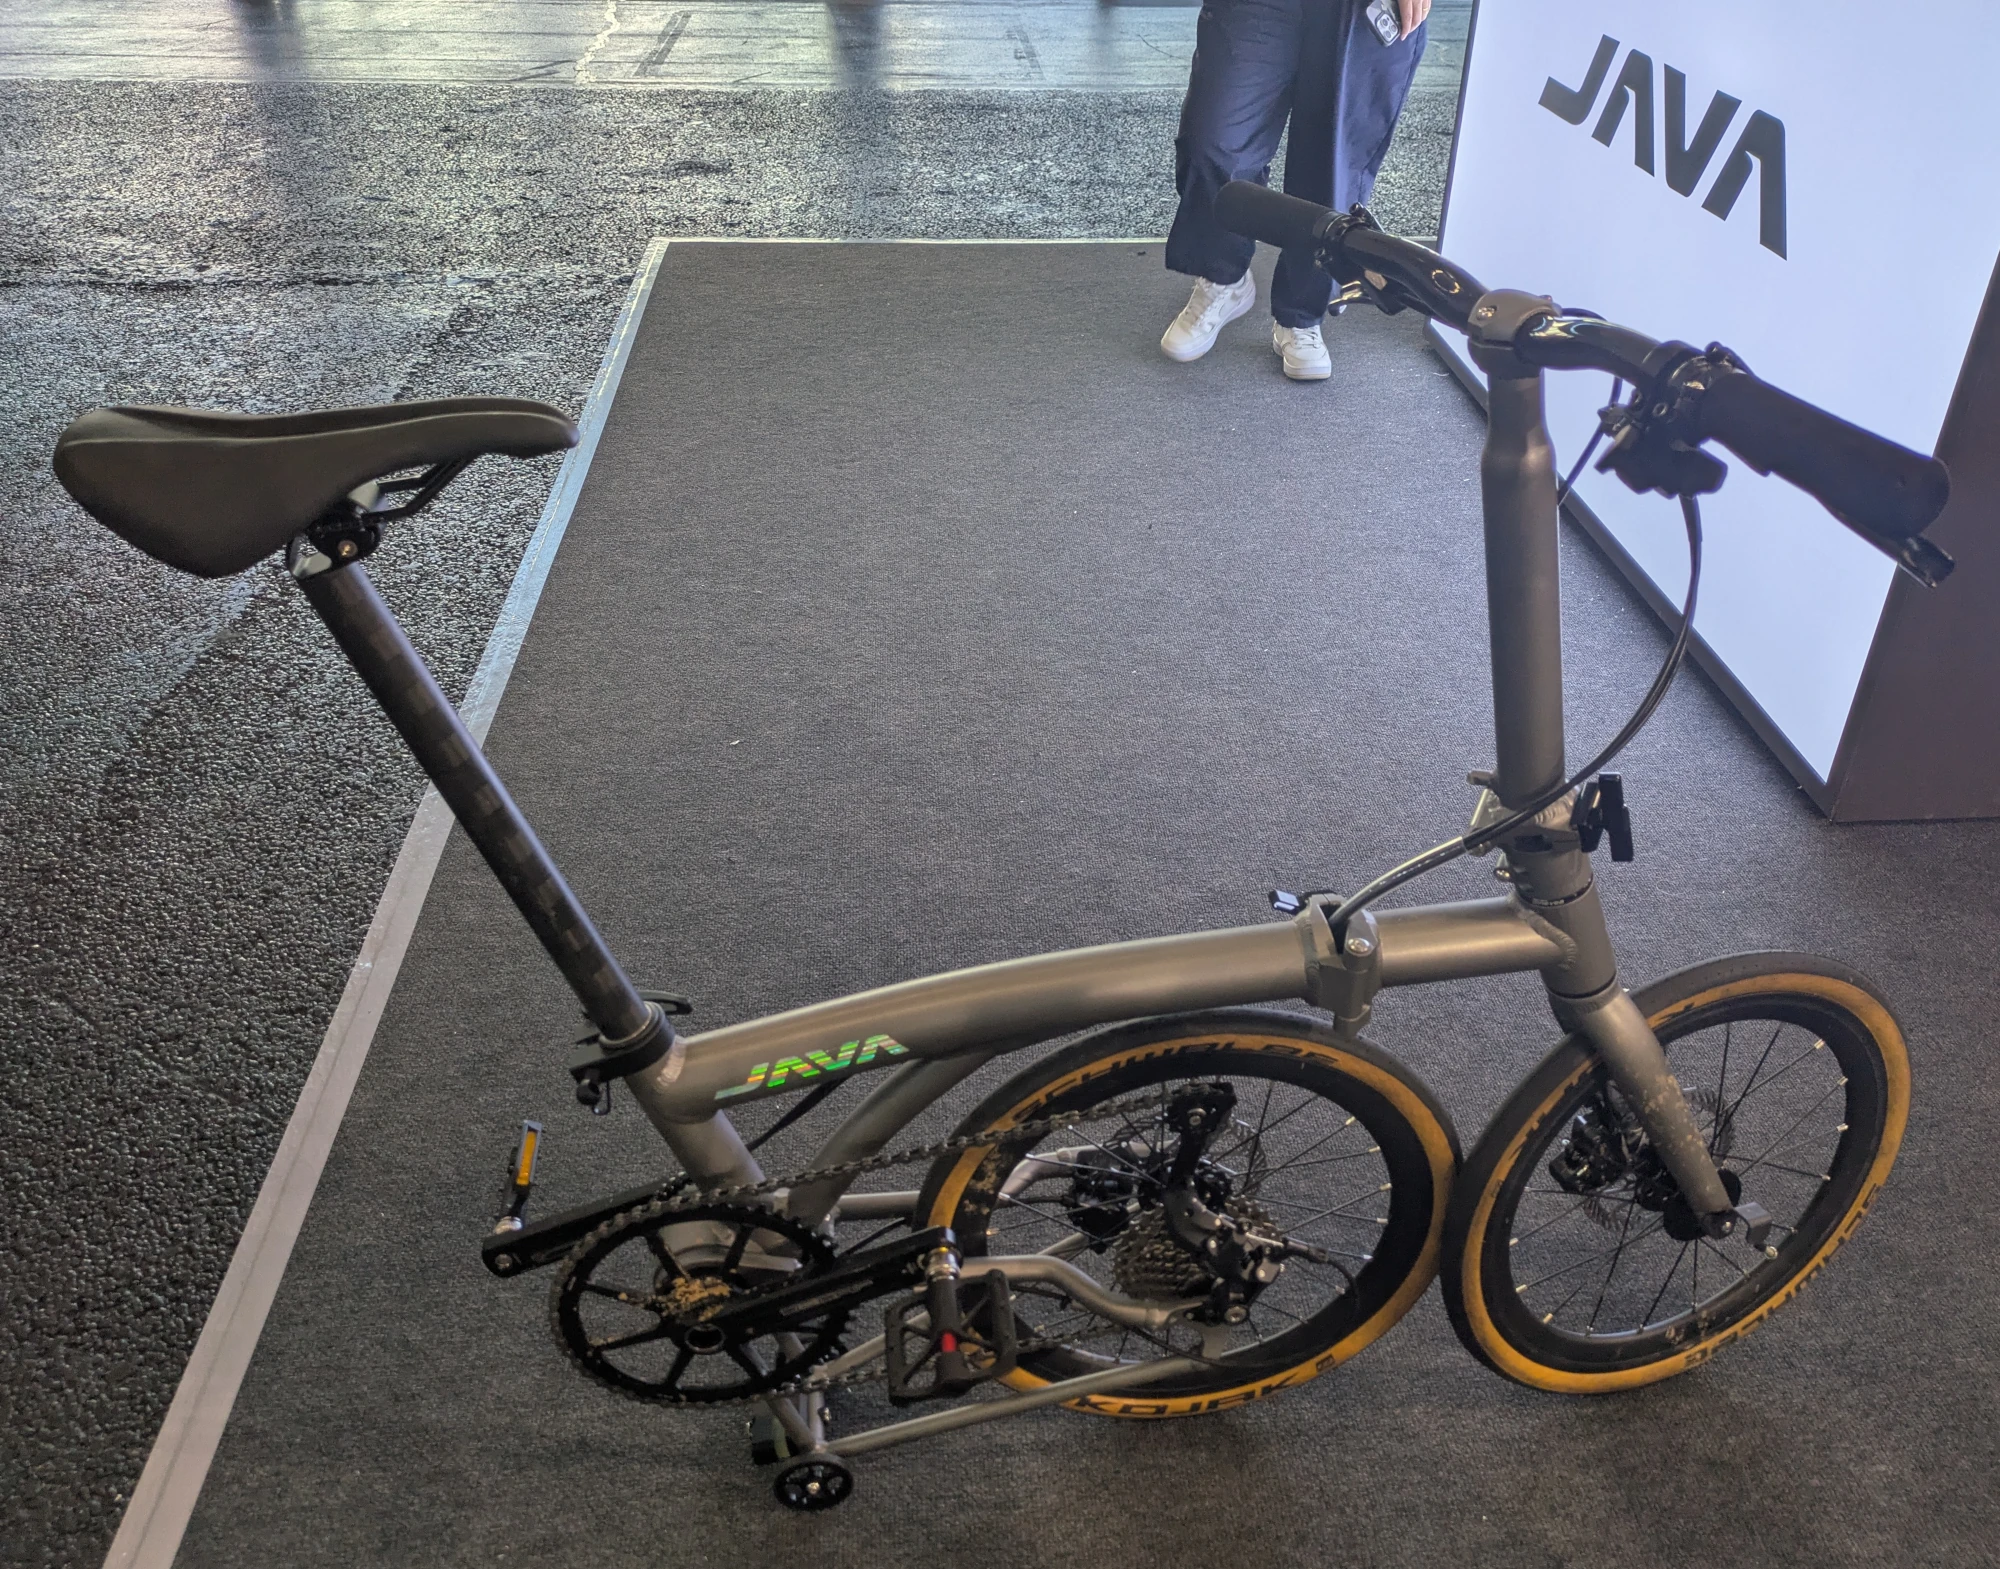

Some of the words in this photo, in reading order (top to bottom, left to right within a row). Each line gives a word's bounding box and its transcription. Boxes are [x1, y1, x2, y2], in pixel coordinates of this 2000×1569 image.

[1538, 34, 1788, 260] JAVA
[715, 1034, 909, 1099] JAVA
[1073, 1371, 1299, 1416] KOJAK
